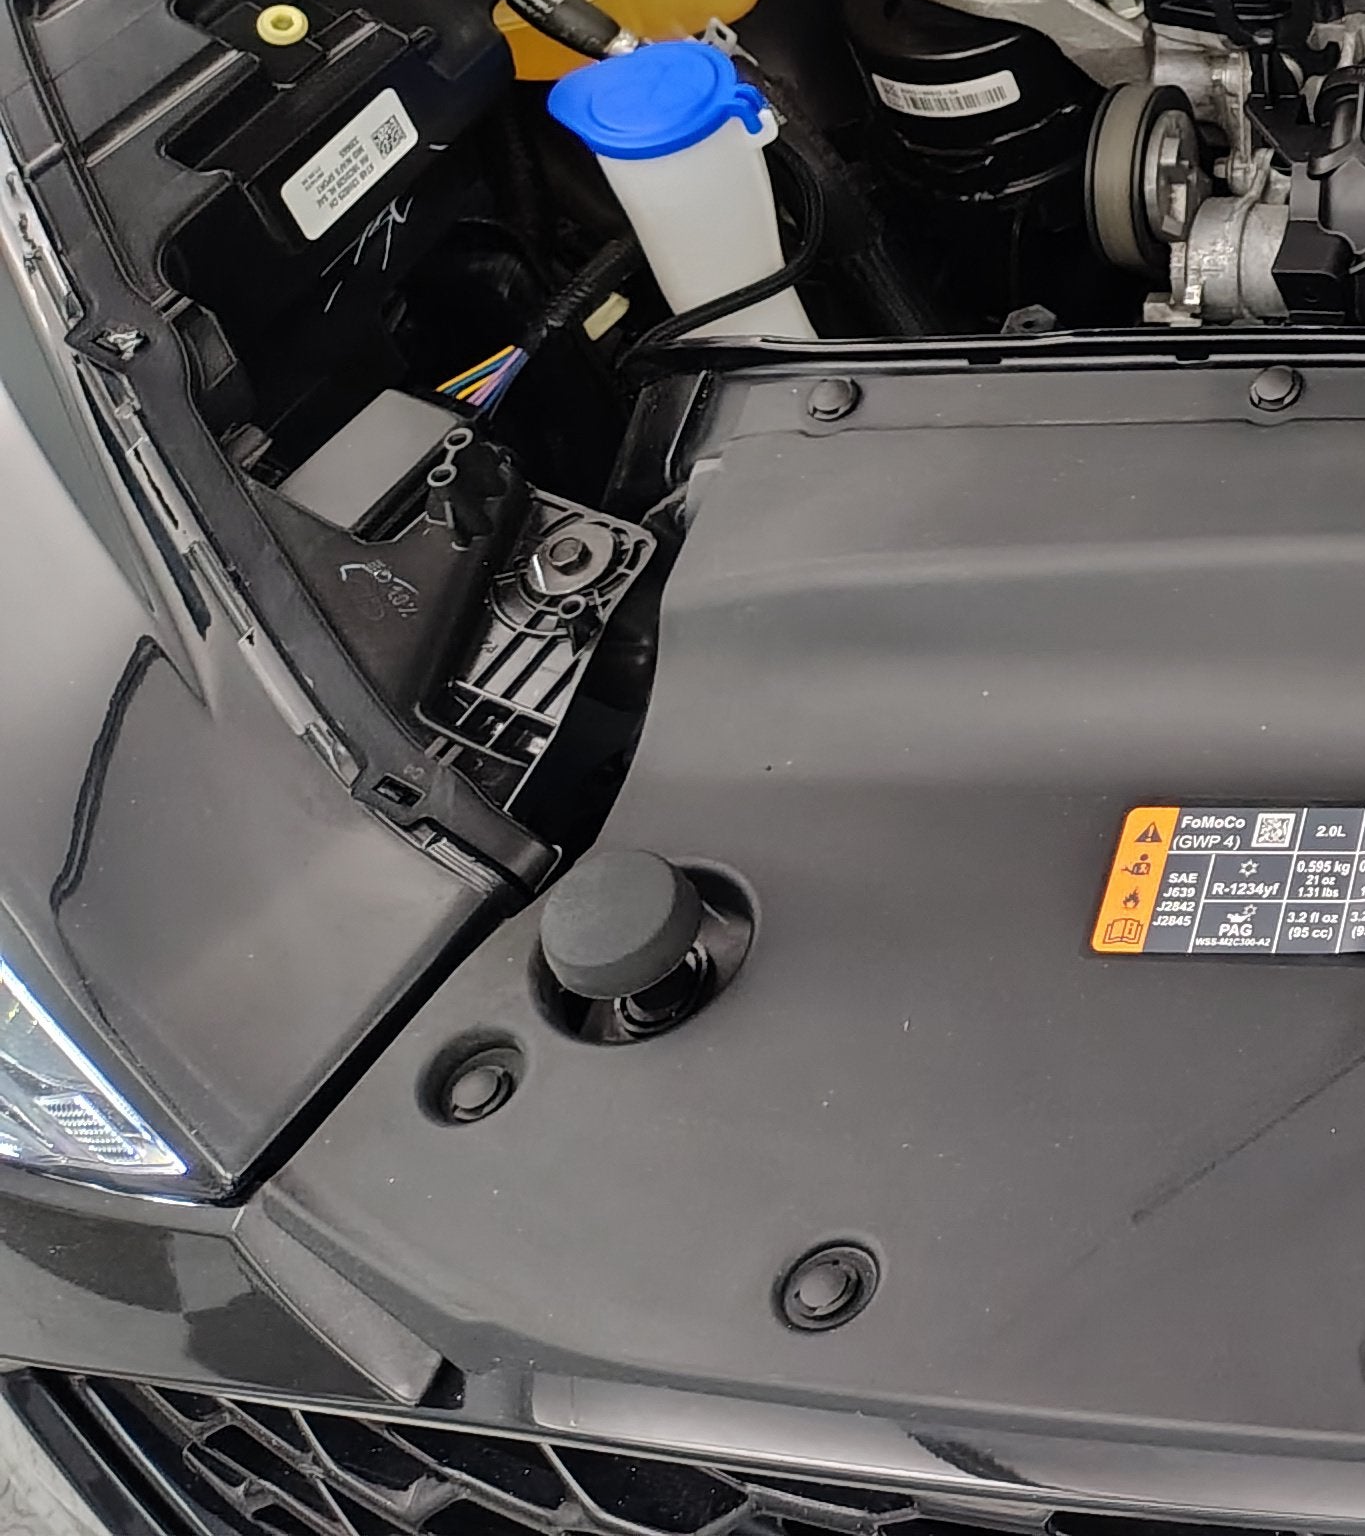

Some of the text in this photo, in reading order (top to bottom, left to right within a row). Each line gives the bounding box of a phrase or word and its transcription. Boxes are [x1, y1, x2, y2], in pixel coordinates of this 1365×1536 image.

[1181, 815, 1247, 830] FoMoCo
[1316, 825, 1346, 837] 2.0L
[1173, 834, 1241, 850] (GWP 4)
[1296, 860, 1350, 877] 0.595 kg
[1168, 872, 1198, 884] SAE
[1306, 875, 1335, 886] 21 oz
[1162, 886, 1196, 899] J639
[1212, 883, 1280, 899] R-1234yf
[1298, 886, 1339, 898] 1.31 lbs
[1156, 901, 1195, 913] J2842
[1152, 915, 1192, 927] J2845
[1286, 912, 1338, 924] 3.2 fl oz
[1219, 923, 1253, 937] PAG
[1288, 926, 1333, 940] (95 cc)
